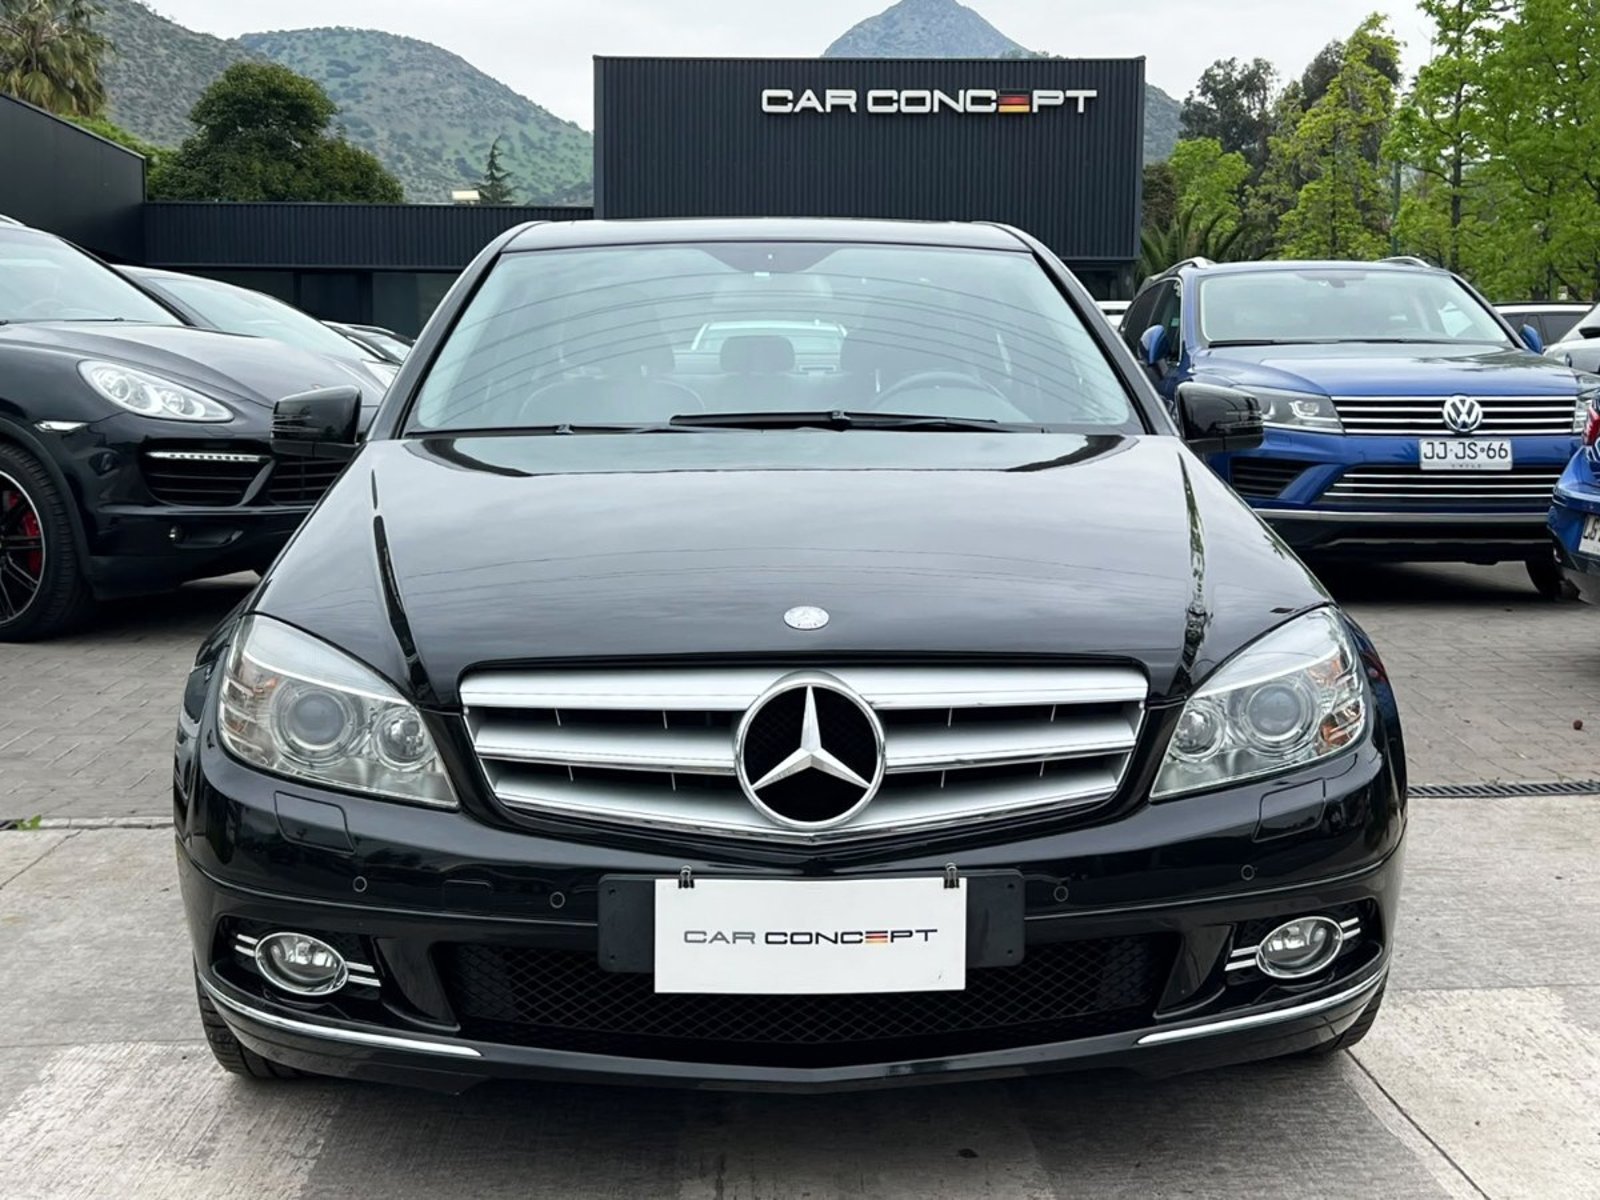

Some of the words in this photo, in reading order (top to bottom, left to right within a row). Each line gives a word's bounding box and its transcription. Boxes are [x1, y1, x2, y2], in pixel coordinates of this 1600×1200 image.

[761, 89, 857, 113] CAR
[867, 89, 1097, 113] CONCEPT
[684, 930, 756, 945] CAR
[765, 928, 938, 945] CONCEPT
